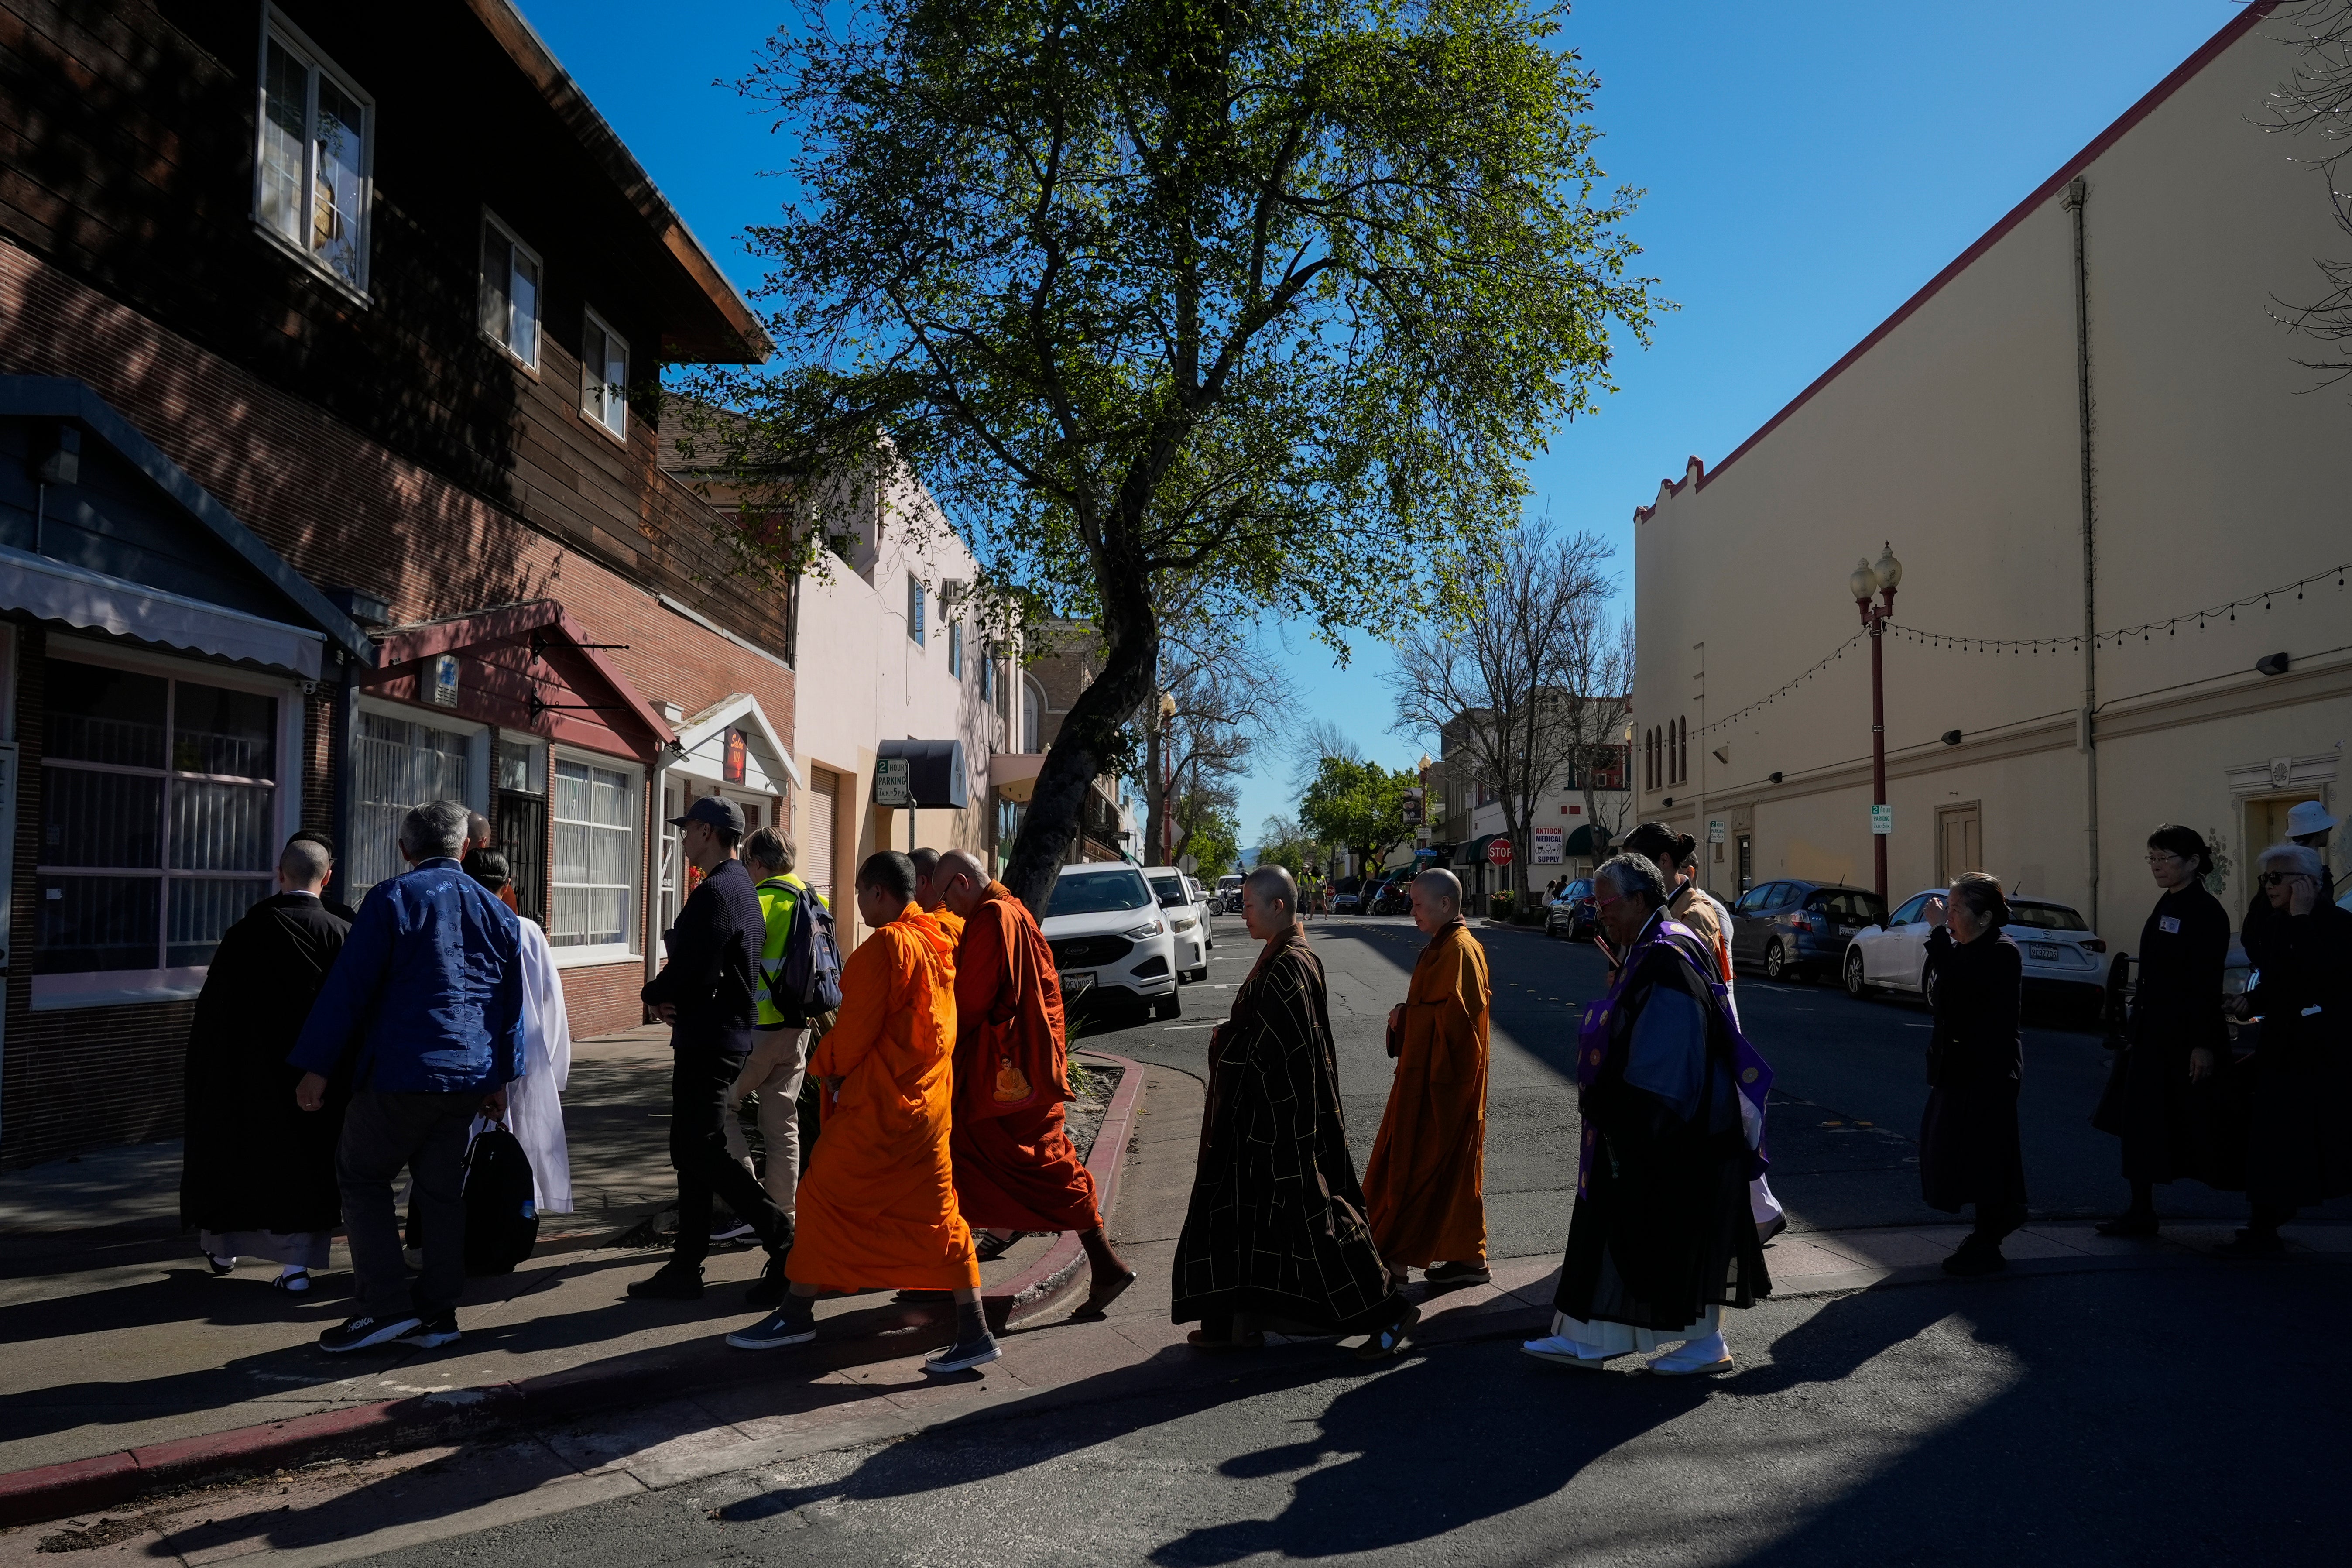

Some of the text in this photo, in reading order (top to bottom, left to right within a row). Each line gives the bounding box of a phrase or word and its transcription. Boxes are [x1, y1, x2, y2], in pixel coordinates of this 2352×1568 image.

[730, 734, 744, 750] Salon
[879, 761, 886, 772] 2
[879, 777, 906, 785] PARKING
[1489, 847, 1512, 858] STOP
[347, 1317, 374, 1333] HOKA
